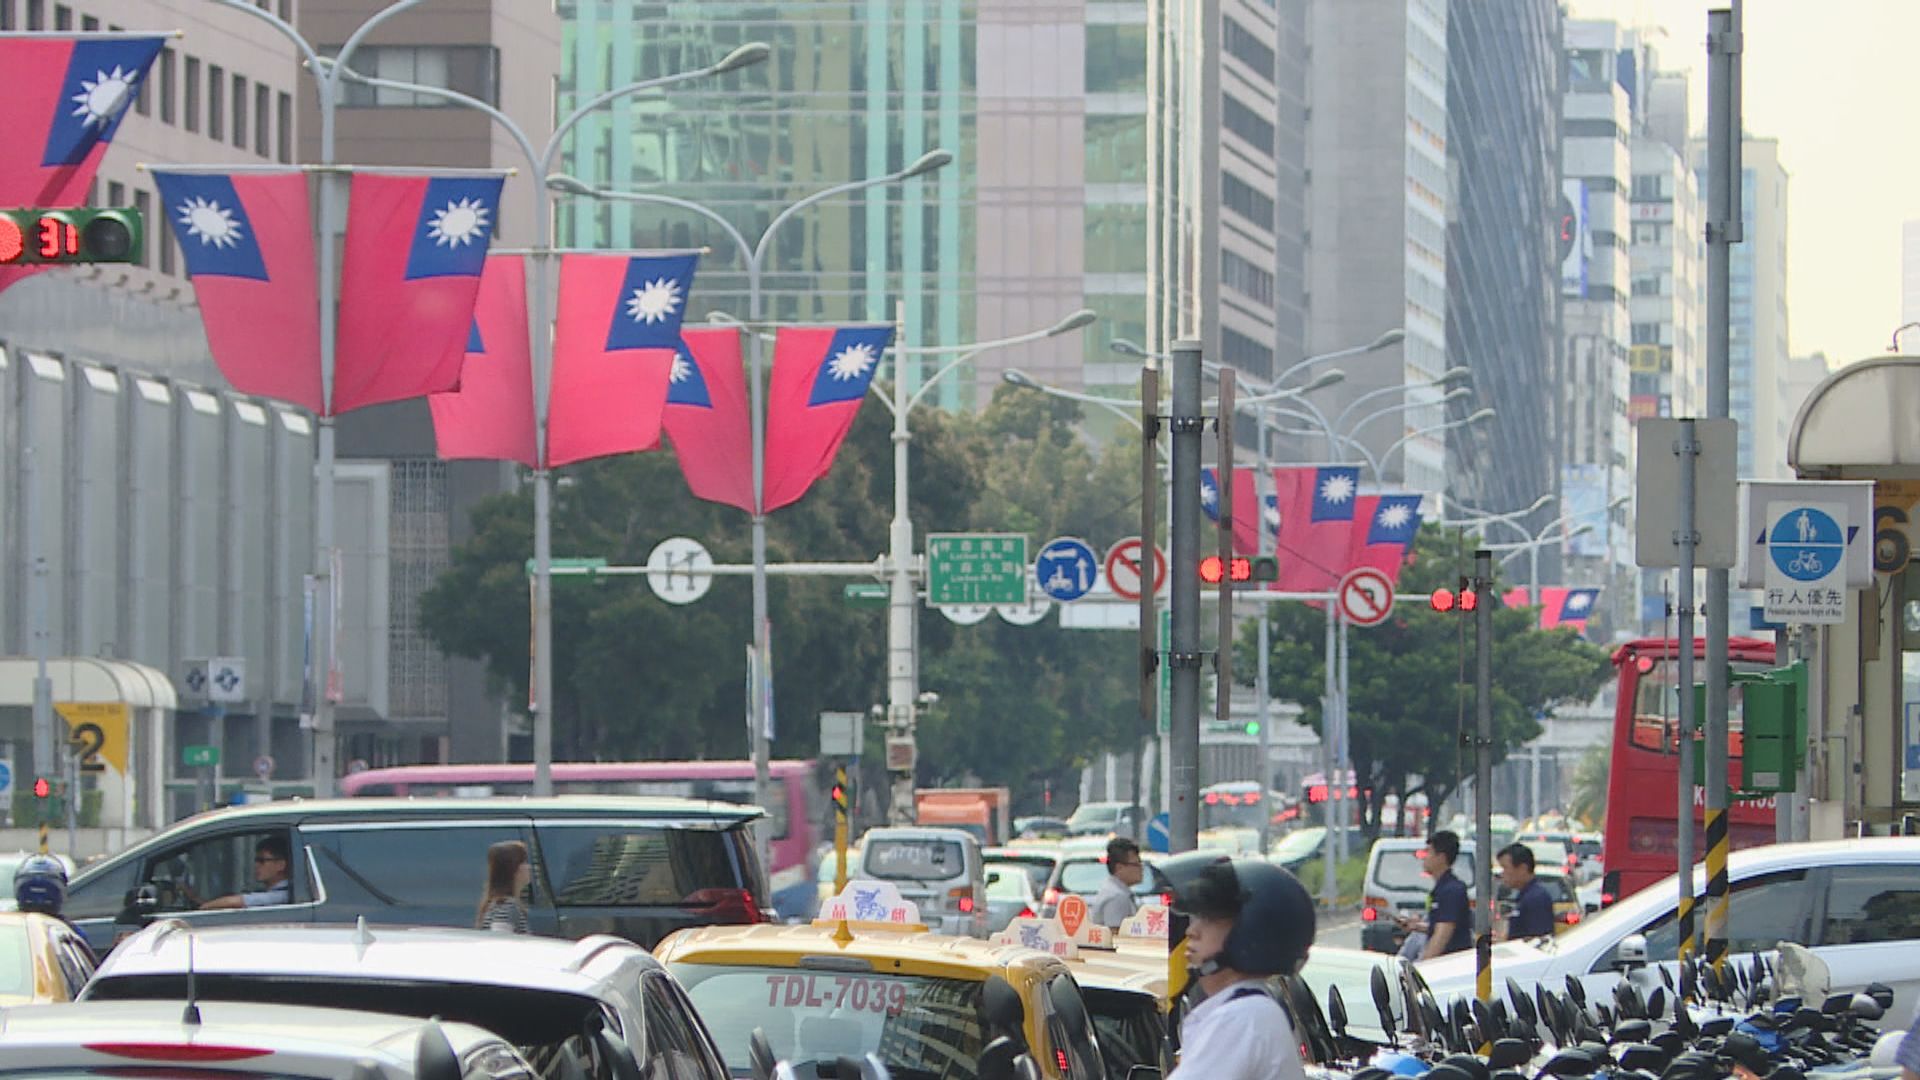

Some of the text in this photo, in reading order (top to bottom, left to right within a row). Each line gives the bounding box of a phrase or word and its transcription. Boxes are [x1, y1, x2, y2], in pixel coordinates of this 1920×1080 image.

[39, 217, 79, 258] 31
[1875, 505, 1910, 573] 6
[1768, 589, 1842, 606] 行人優先
[73, 721, 106, 772] 2
[766, 975, 907, 1016] TDL-7039
